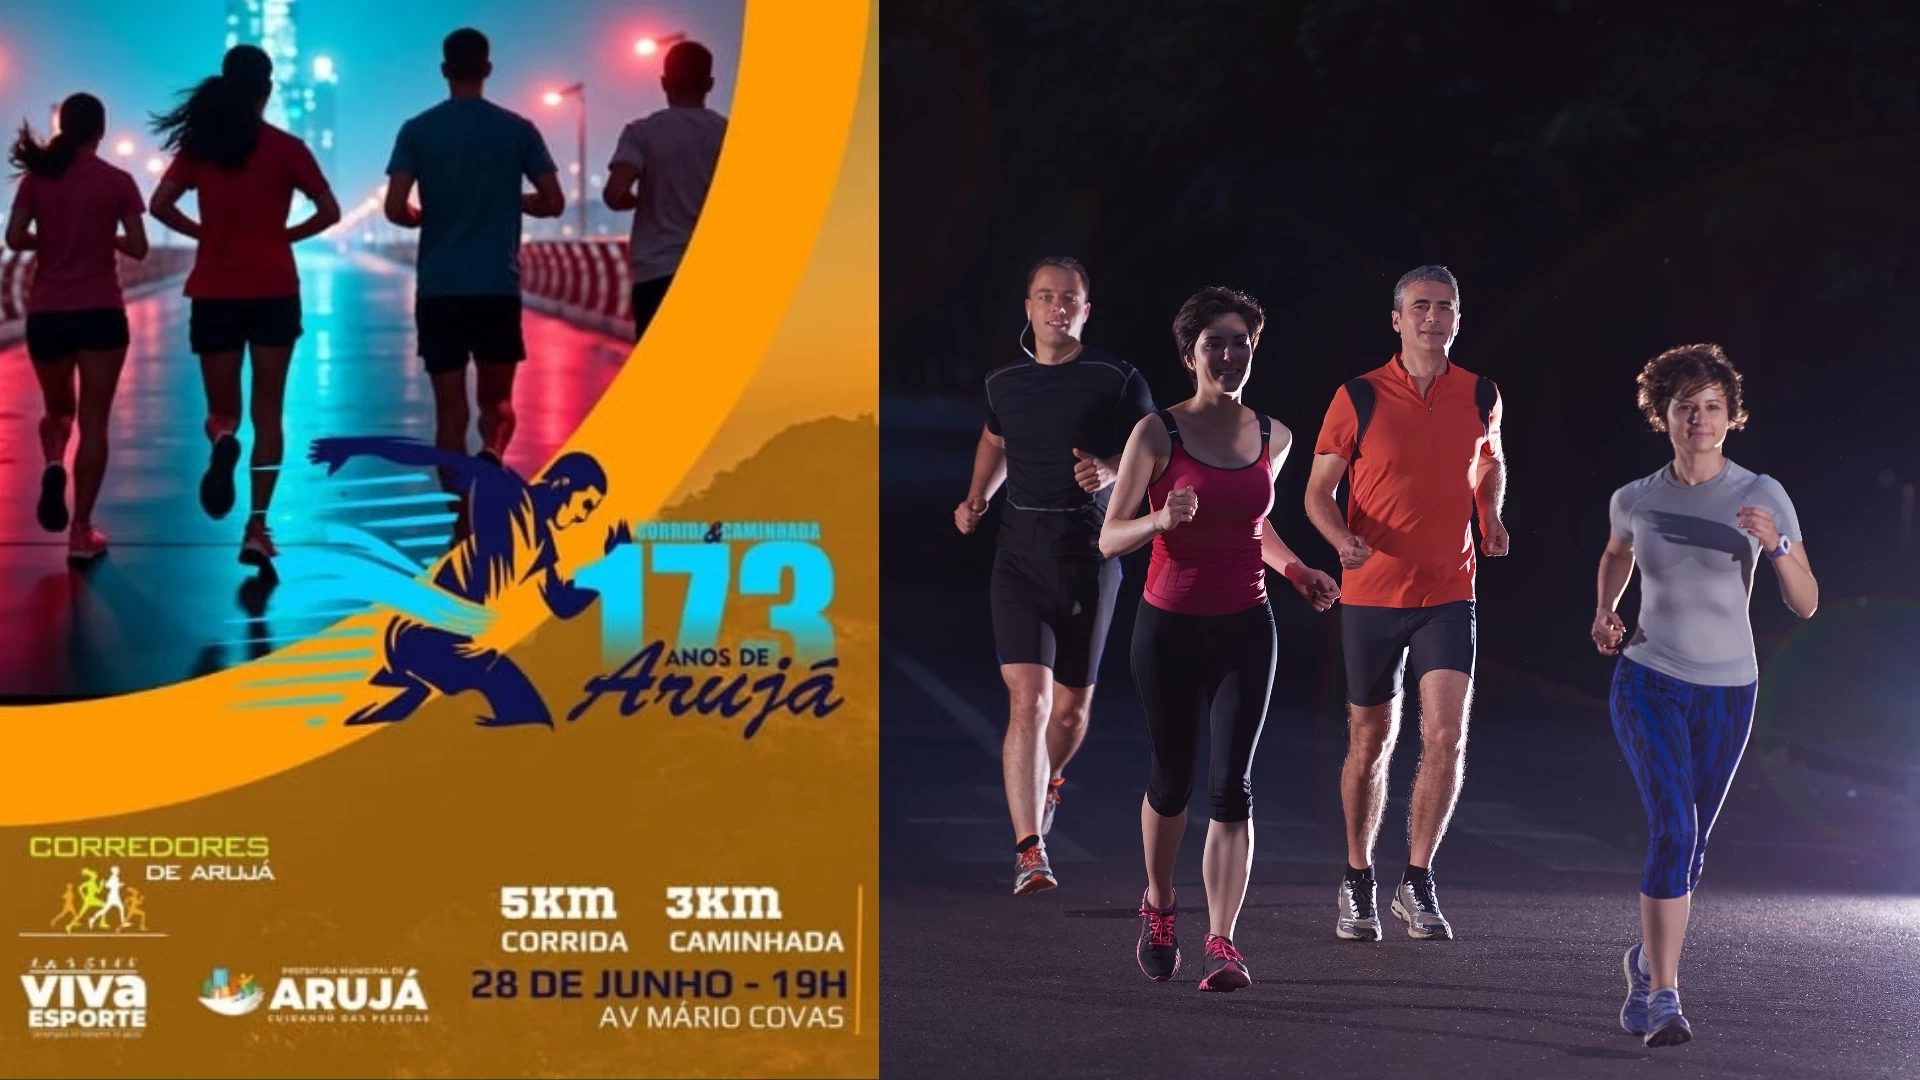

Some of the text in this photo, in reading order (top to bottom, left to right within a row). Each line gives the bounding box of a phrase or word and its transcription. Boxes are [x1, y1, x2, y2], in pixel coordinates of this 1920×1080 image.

[704, 521, 723, 543] &
[573, 541, 836, 670] 173
[664, 648, 769, 667] ANOS DE
[566, 640, 845, 740] Arujá
[29, 836, 269, 859] CORREDORES
[146, 859, 276, 881] DE ARUJÁ
[501, 931, 629, 953] CORRIDA
[669, 931, 844, 953] CAMINHADA
[269, 968, 428, 1010] ARUJÁ
[471, 969, 519, 1000] 28
[530, 969, 583, 999] DE
[594, 969, 733, 999] JUNHO
[772, 969, 848, 999] 19H
[28, 1008, 147, 1028] ESPORTE
[599, 1000, 844, 1029] AV MÁRIO COVAS
